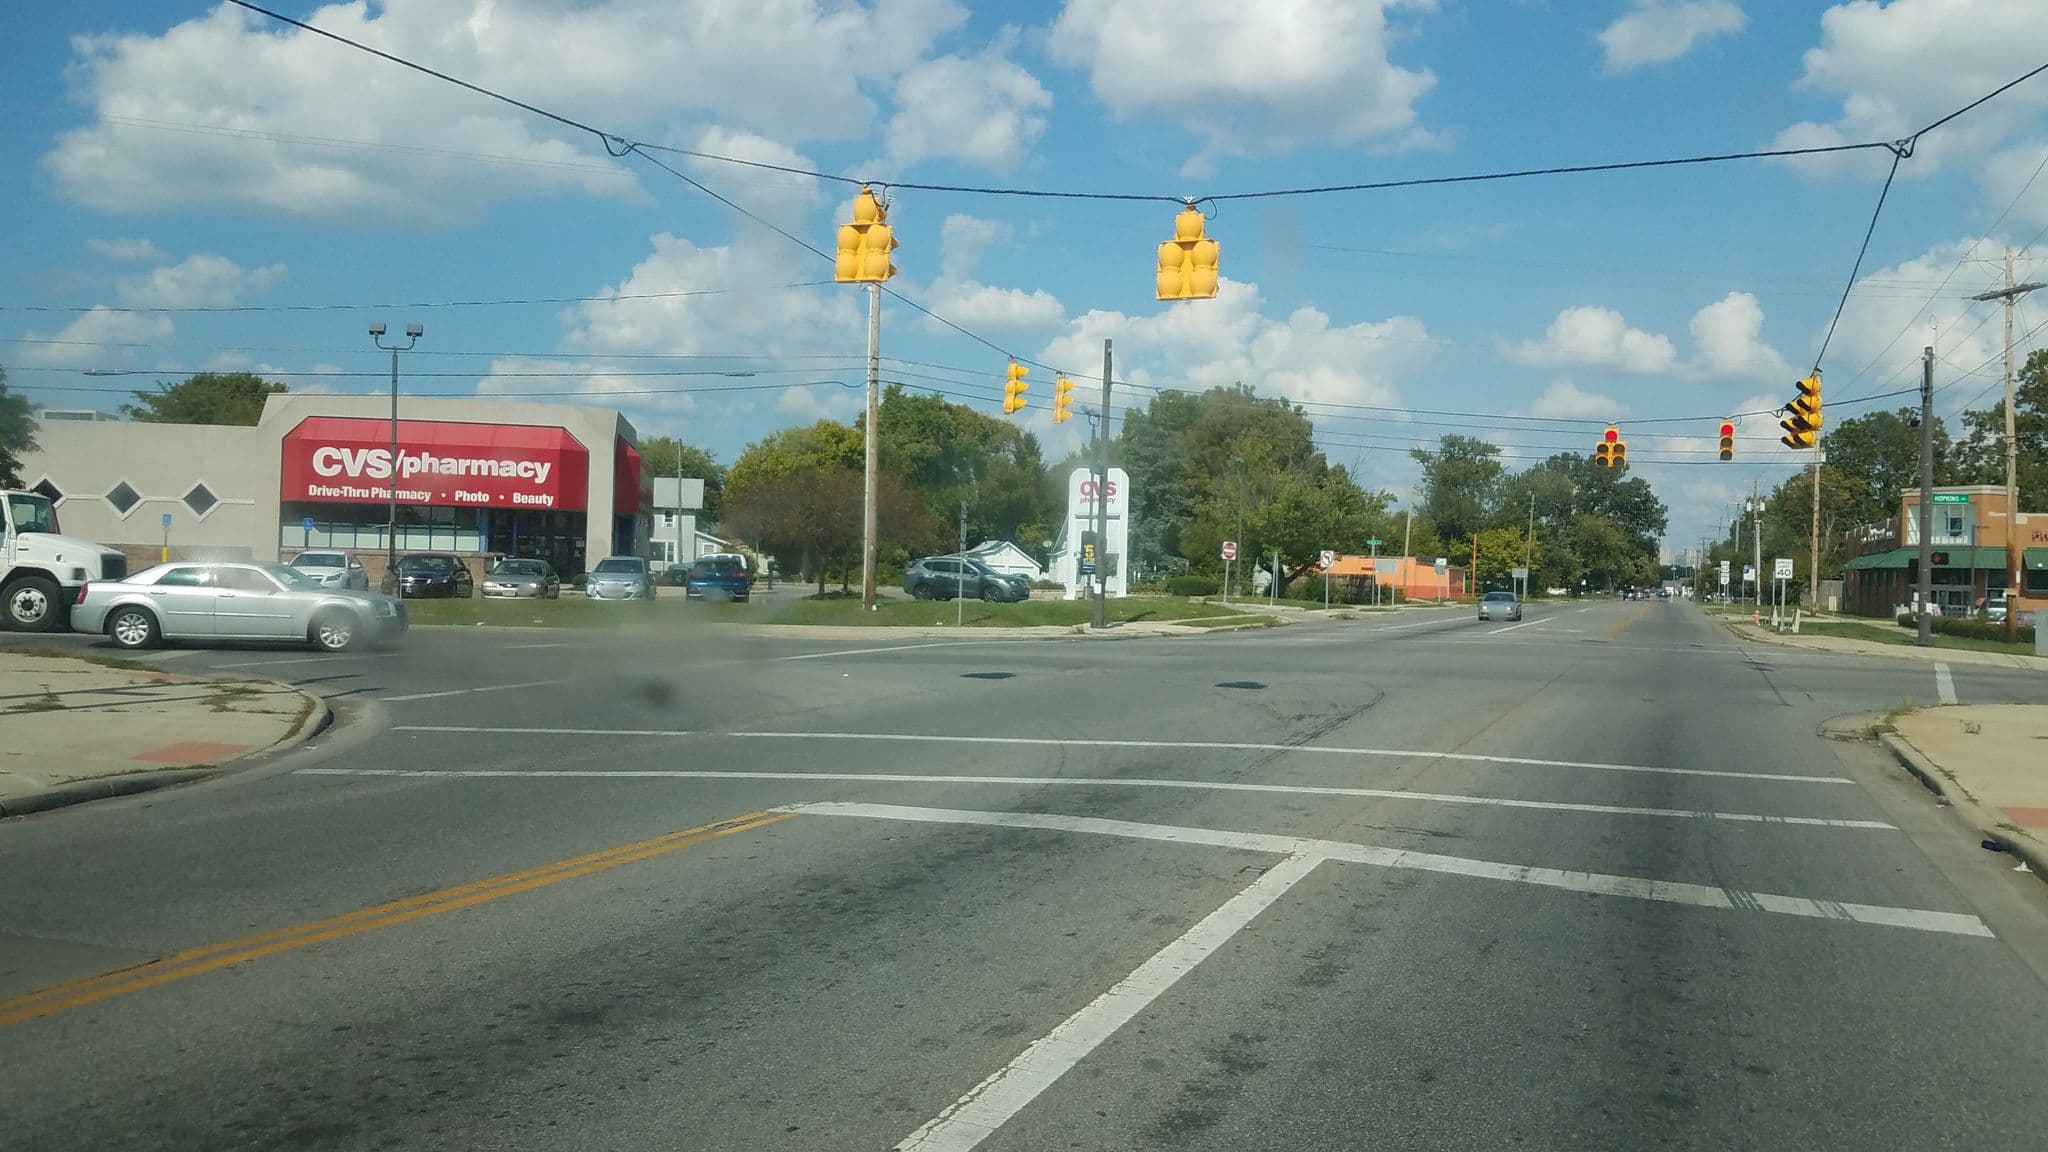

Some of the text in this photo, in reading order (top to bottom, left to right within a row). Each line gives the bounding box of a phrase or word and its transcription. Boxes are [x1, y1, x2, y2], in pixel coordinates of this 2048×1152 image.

[308, 484, 554, 507] Drive-Thru Pharmacy Photo Beauty
